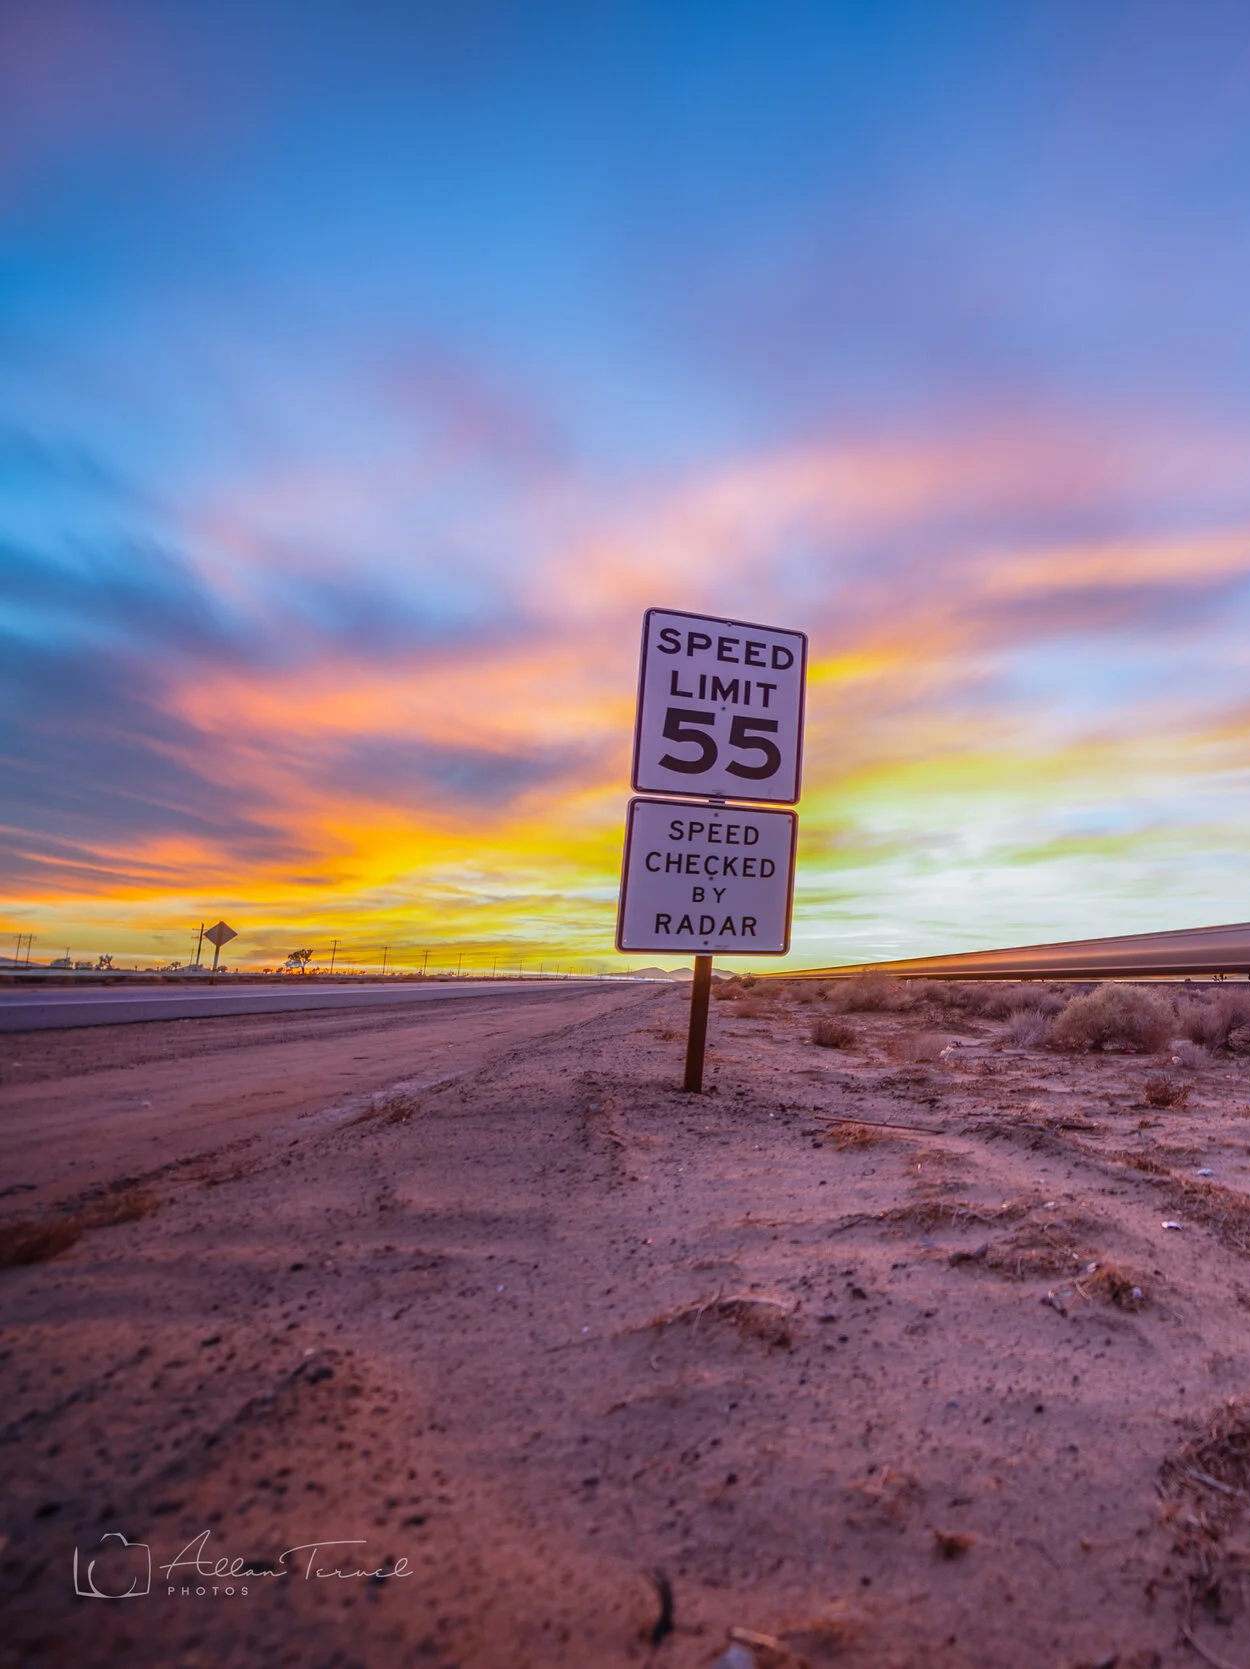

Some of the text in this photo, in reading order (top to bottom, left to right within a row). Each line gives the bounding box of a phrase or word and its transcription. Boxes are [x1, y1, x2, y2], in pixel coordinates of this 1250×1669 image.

[656, 627, 795, 671] SPEED
[669, 669, 778, 708] LIMIT
[657, 707, 782, 780] 55
[668, 820, 760, 846] SPEED
[645, 851, 776, 879] CHECKED
[692, 887, 728, 904] BY
[654, 913, 757, 937] RADAR
